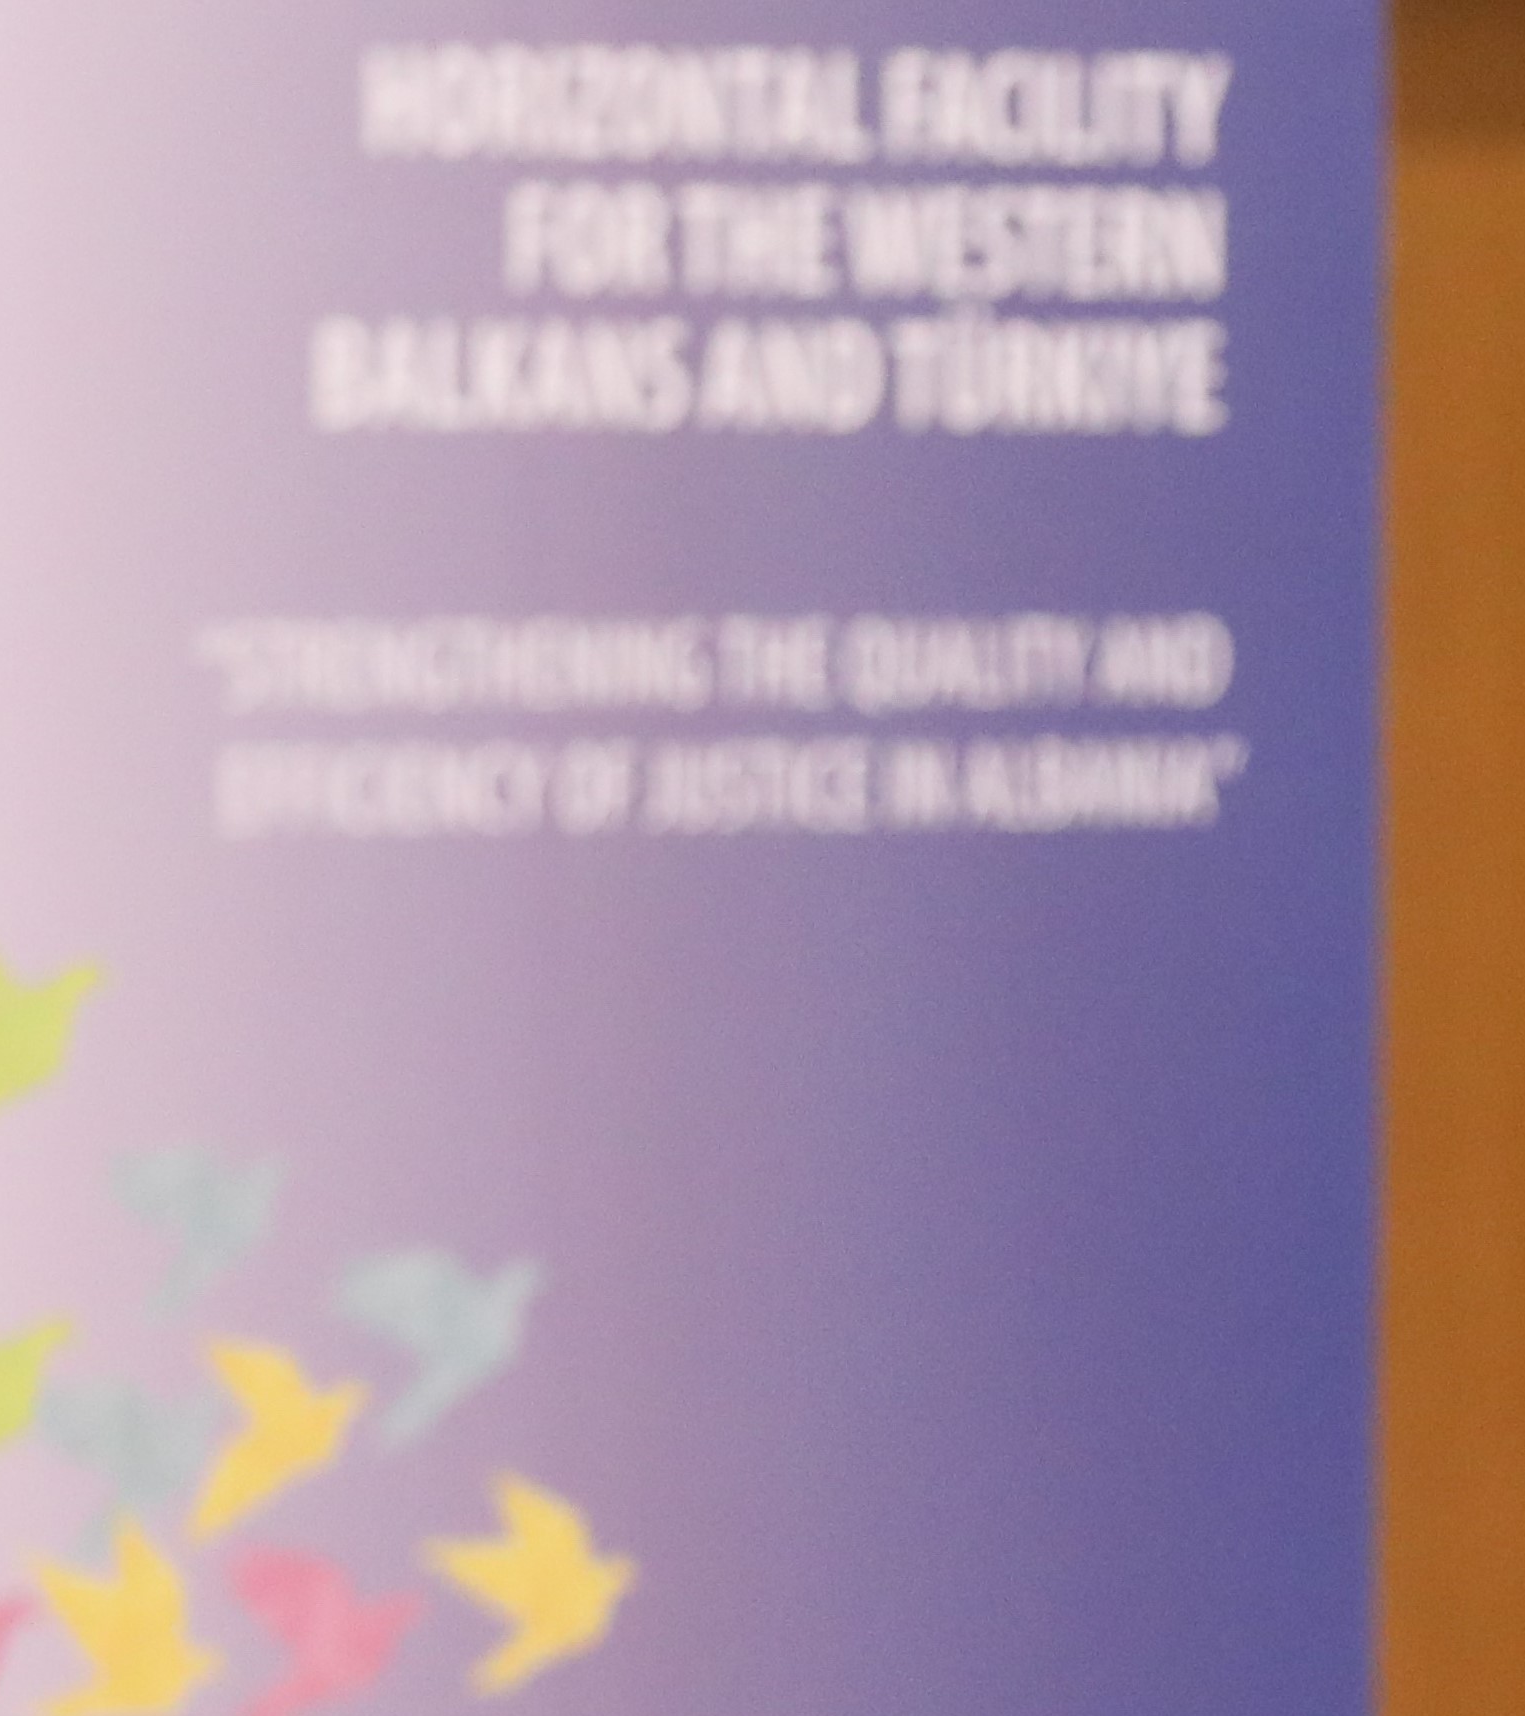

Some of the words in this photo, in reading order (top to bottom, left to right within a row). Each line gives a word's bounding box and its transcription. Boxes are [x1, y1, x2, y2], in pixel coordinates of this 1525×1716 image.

[358, 42, 874, 163] HORIZONTAL
[882, 46, 1232, 167] FACILITY
[503, 178, 673, 298] FOR
[678, 180, 842, 300] THE
[844, 183, 1228, 302] WESTERN
[308, 312, 692, 434] BALKANS
[696, 314, 886, 434] AND
[716, 612, 836, 708] THE
[838, 612, 1088, 718] QUALITY
[1088, 612, 1236, 710] AND
[552, 736, 640, 836] OF
[640, 736, 876, 836] JUSTICE
[882, 736, 956, 832] IN
